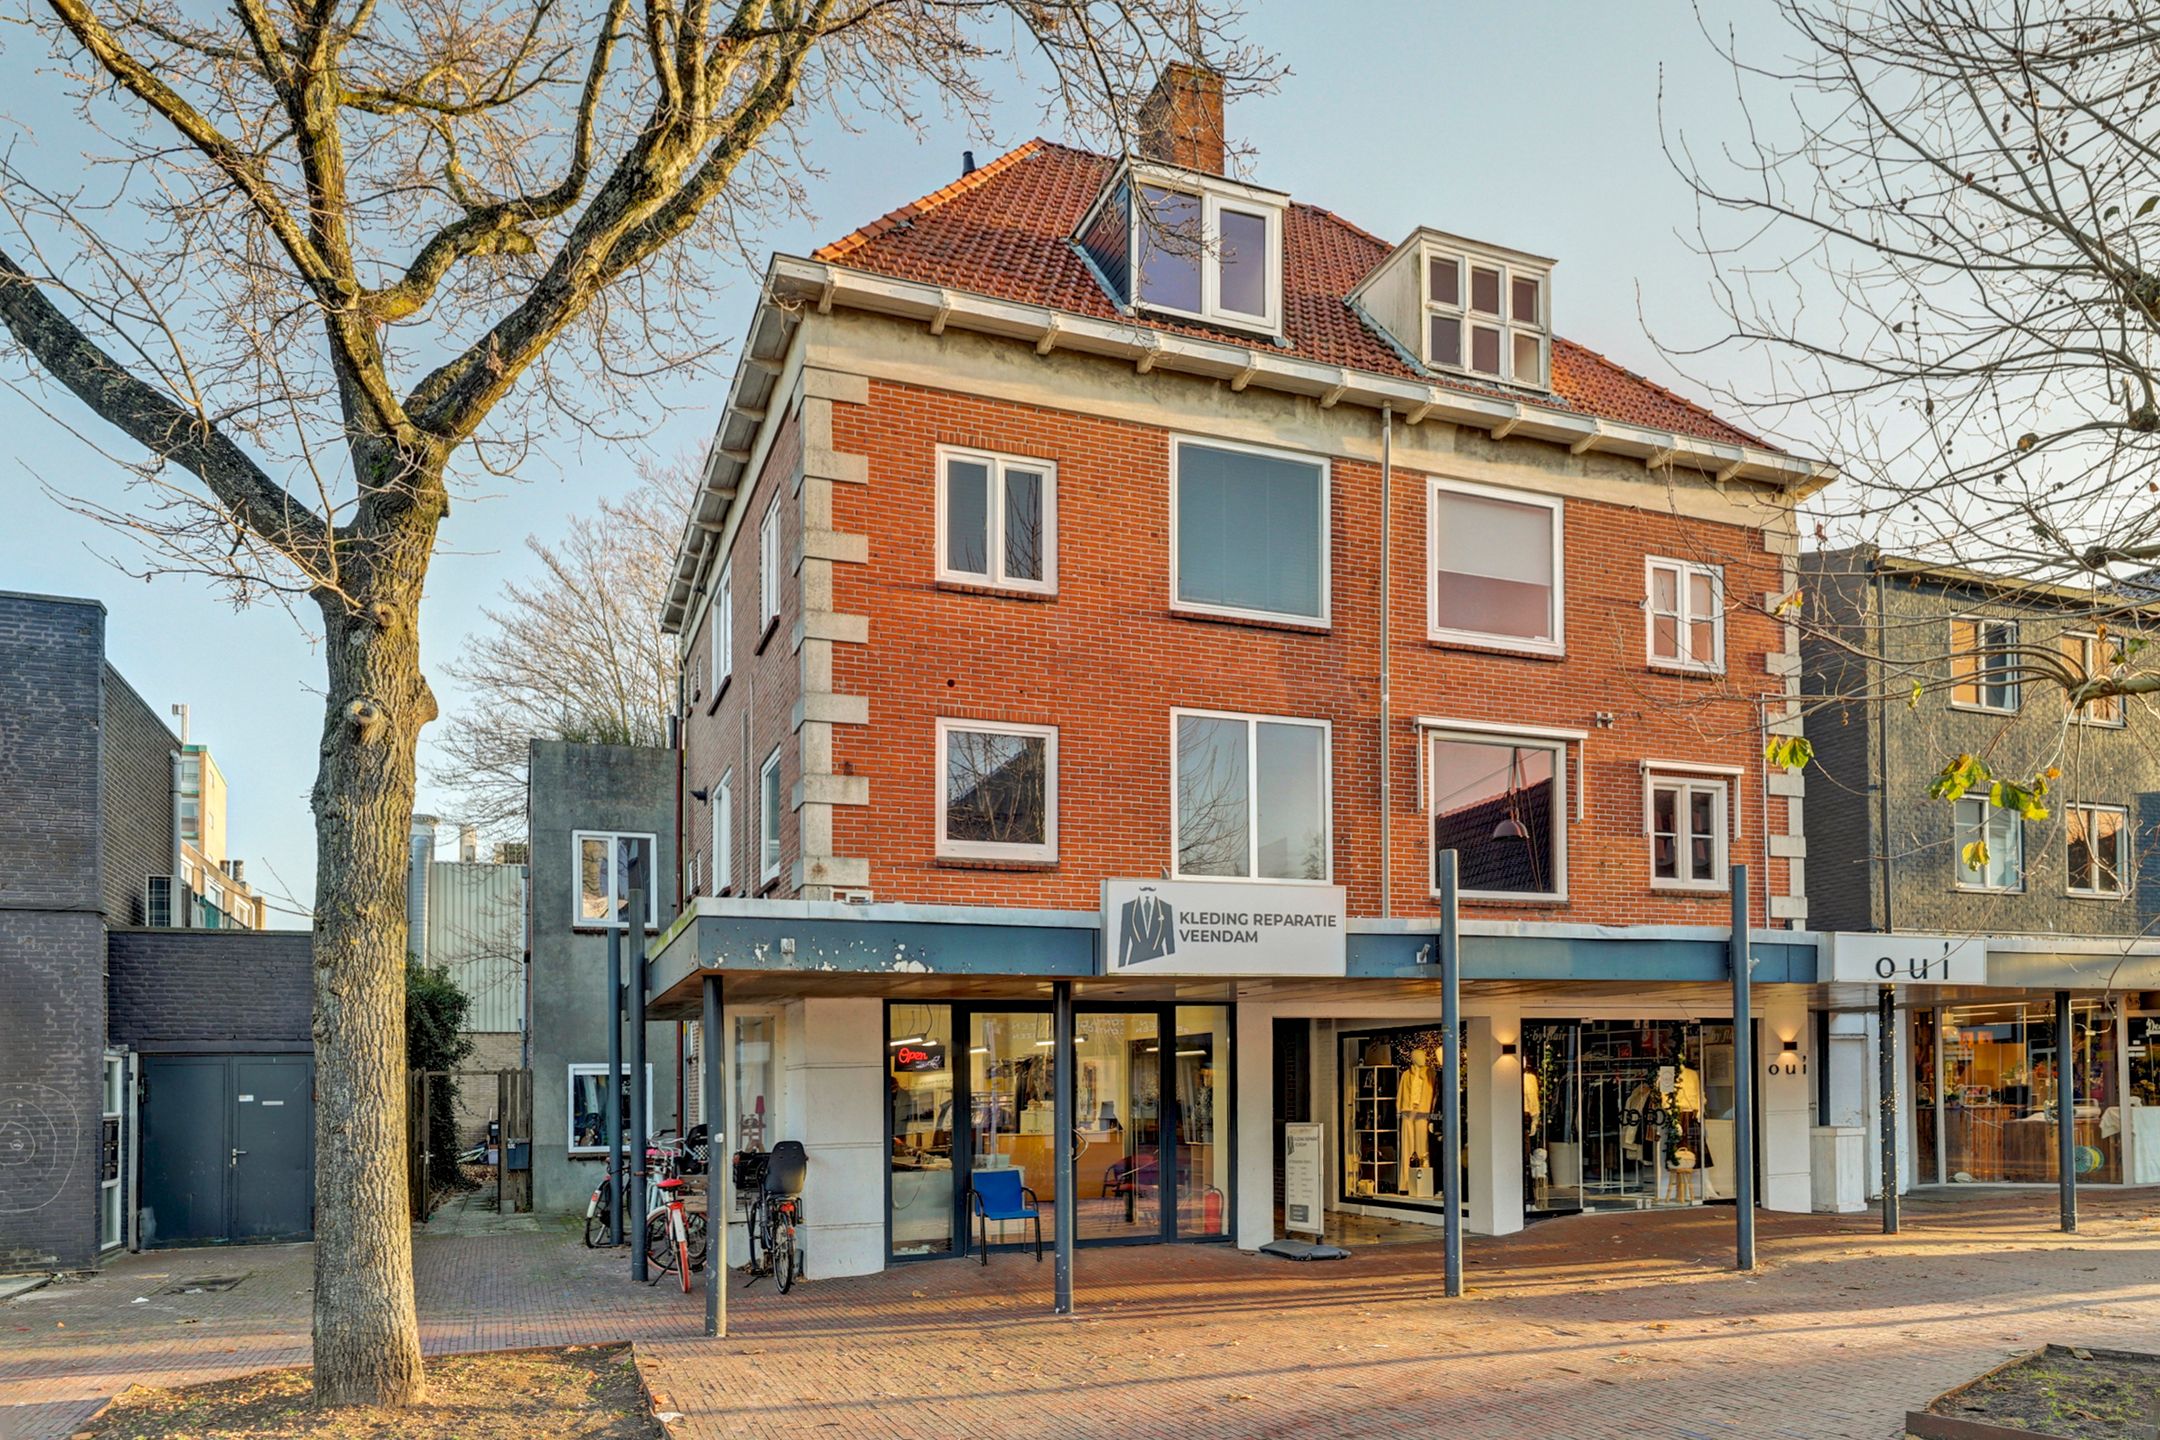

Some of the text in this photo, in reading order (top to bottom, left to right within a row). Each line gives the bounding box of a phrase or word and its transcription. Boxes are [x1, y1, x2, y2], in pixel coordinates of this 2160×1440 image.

[1179, 911, 1337, 928] KLEDING REPARATIE
[1178, 929, 1259, 943] VEENDAM
[898, 1047, 928, 1064] Open
